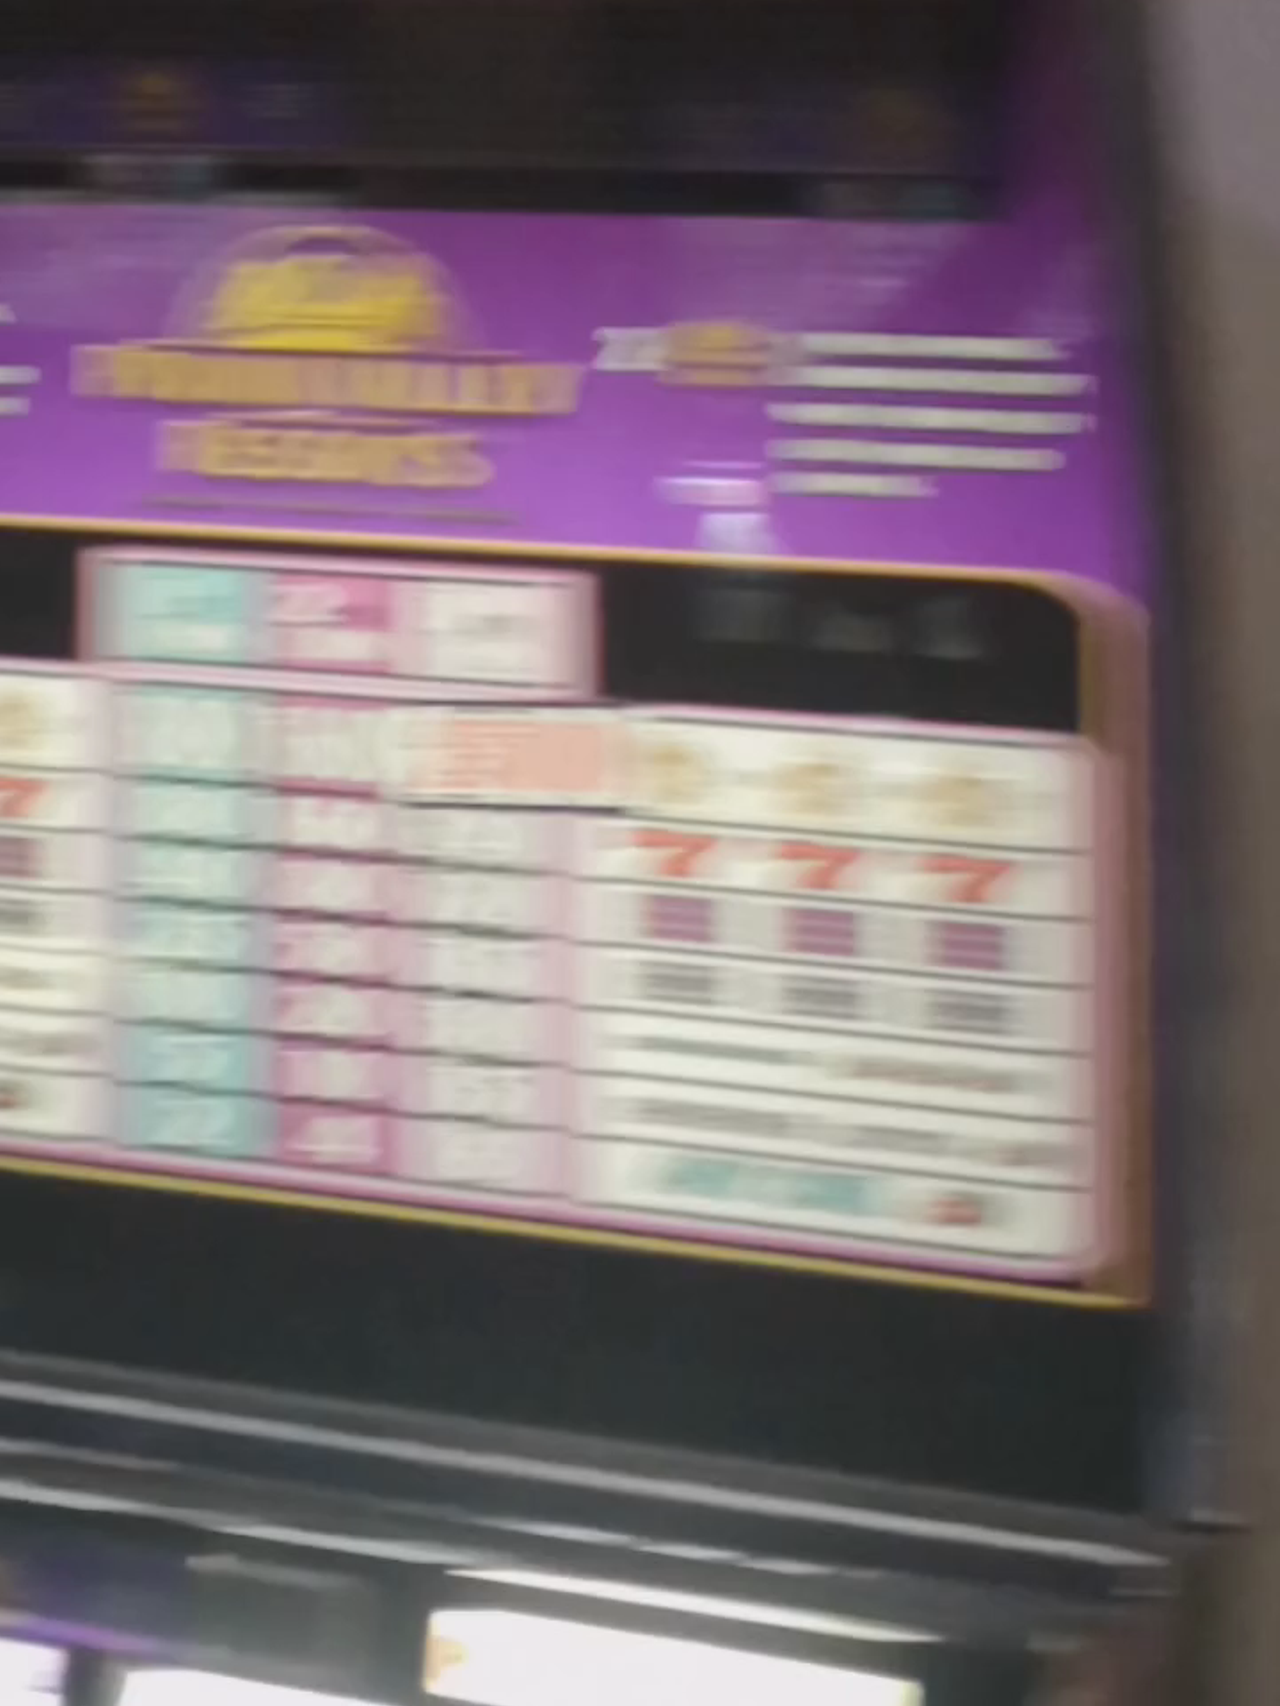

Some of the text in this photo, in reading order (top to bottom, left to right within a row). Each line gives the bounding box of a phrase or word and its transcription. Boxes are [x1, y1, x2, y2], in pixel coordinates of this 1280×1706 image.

[628, 829, 1012, 904] 7 7 7
